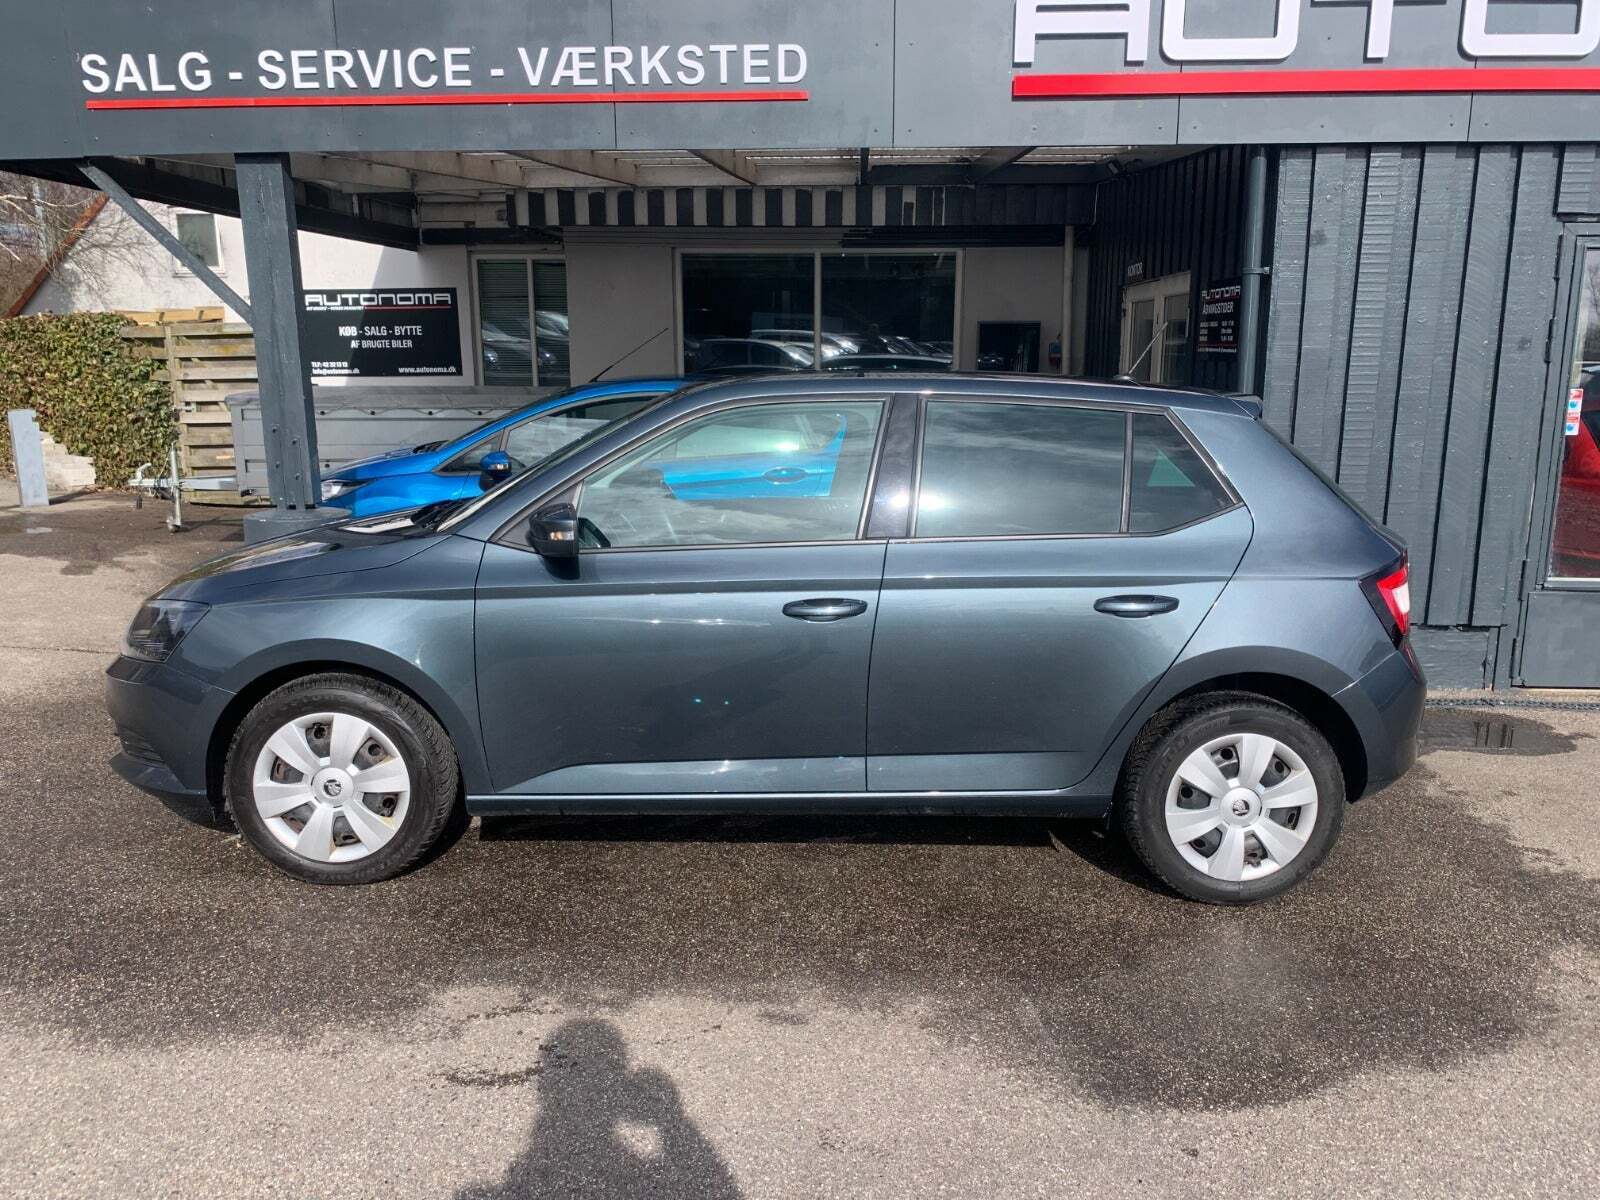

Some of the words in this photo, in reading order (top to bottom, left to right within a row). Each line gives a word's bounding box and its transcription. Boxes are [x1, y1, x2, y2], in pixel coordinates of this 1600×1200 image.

[81, 51, 212, 93] SALG
[257, 46, 472, 90] SERVICE
[517, 43, 808, 86] VÆRKSTED
[1202, 285, 1241, 300] AUTONOMA
[304, 293, 452, 306] AUTONOMA
[338, 326, 358, 337] KØB
[364, 326, 387, 336] SALG
[394, 325, 423, 336] BYTTE
[351, 340, 360, 349] AF
[361, 340, 390, 349] BRUGTE
[391, 340, 413, 348] BILER
[398, 366, 457, 374] www.autonoma.dk
